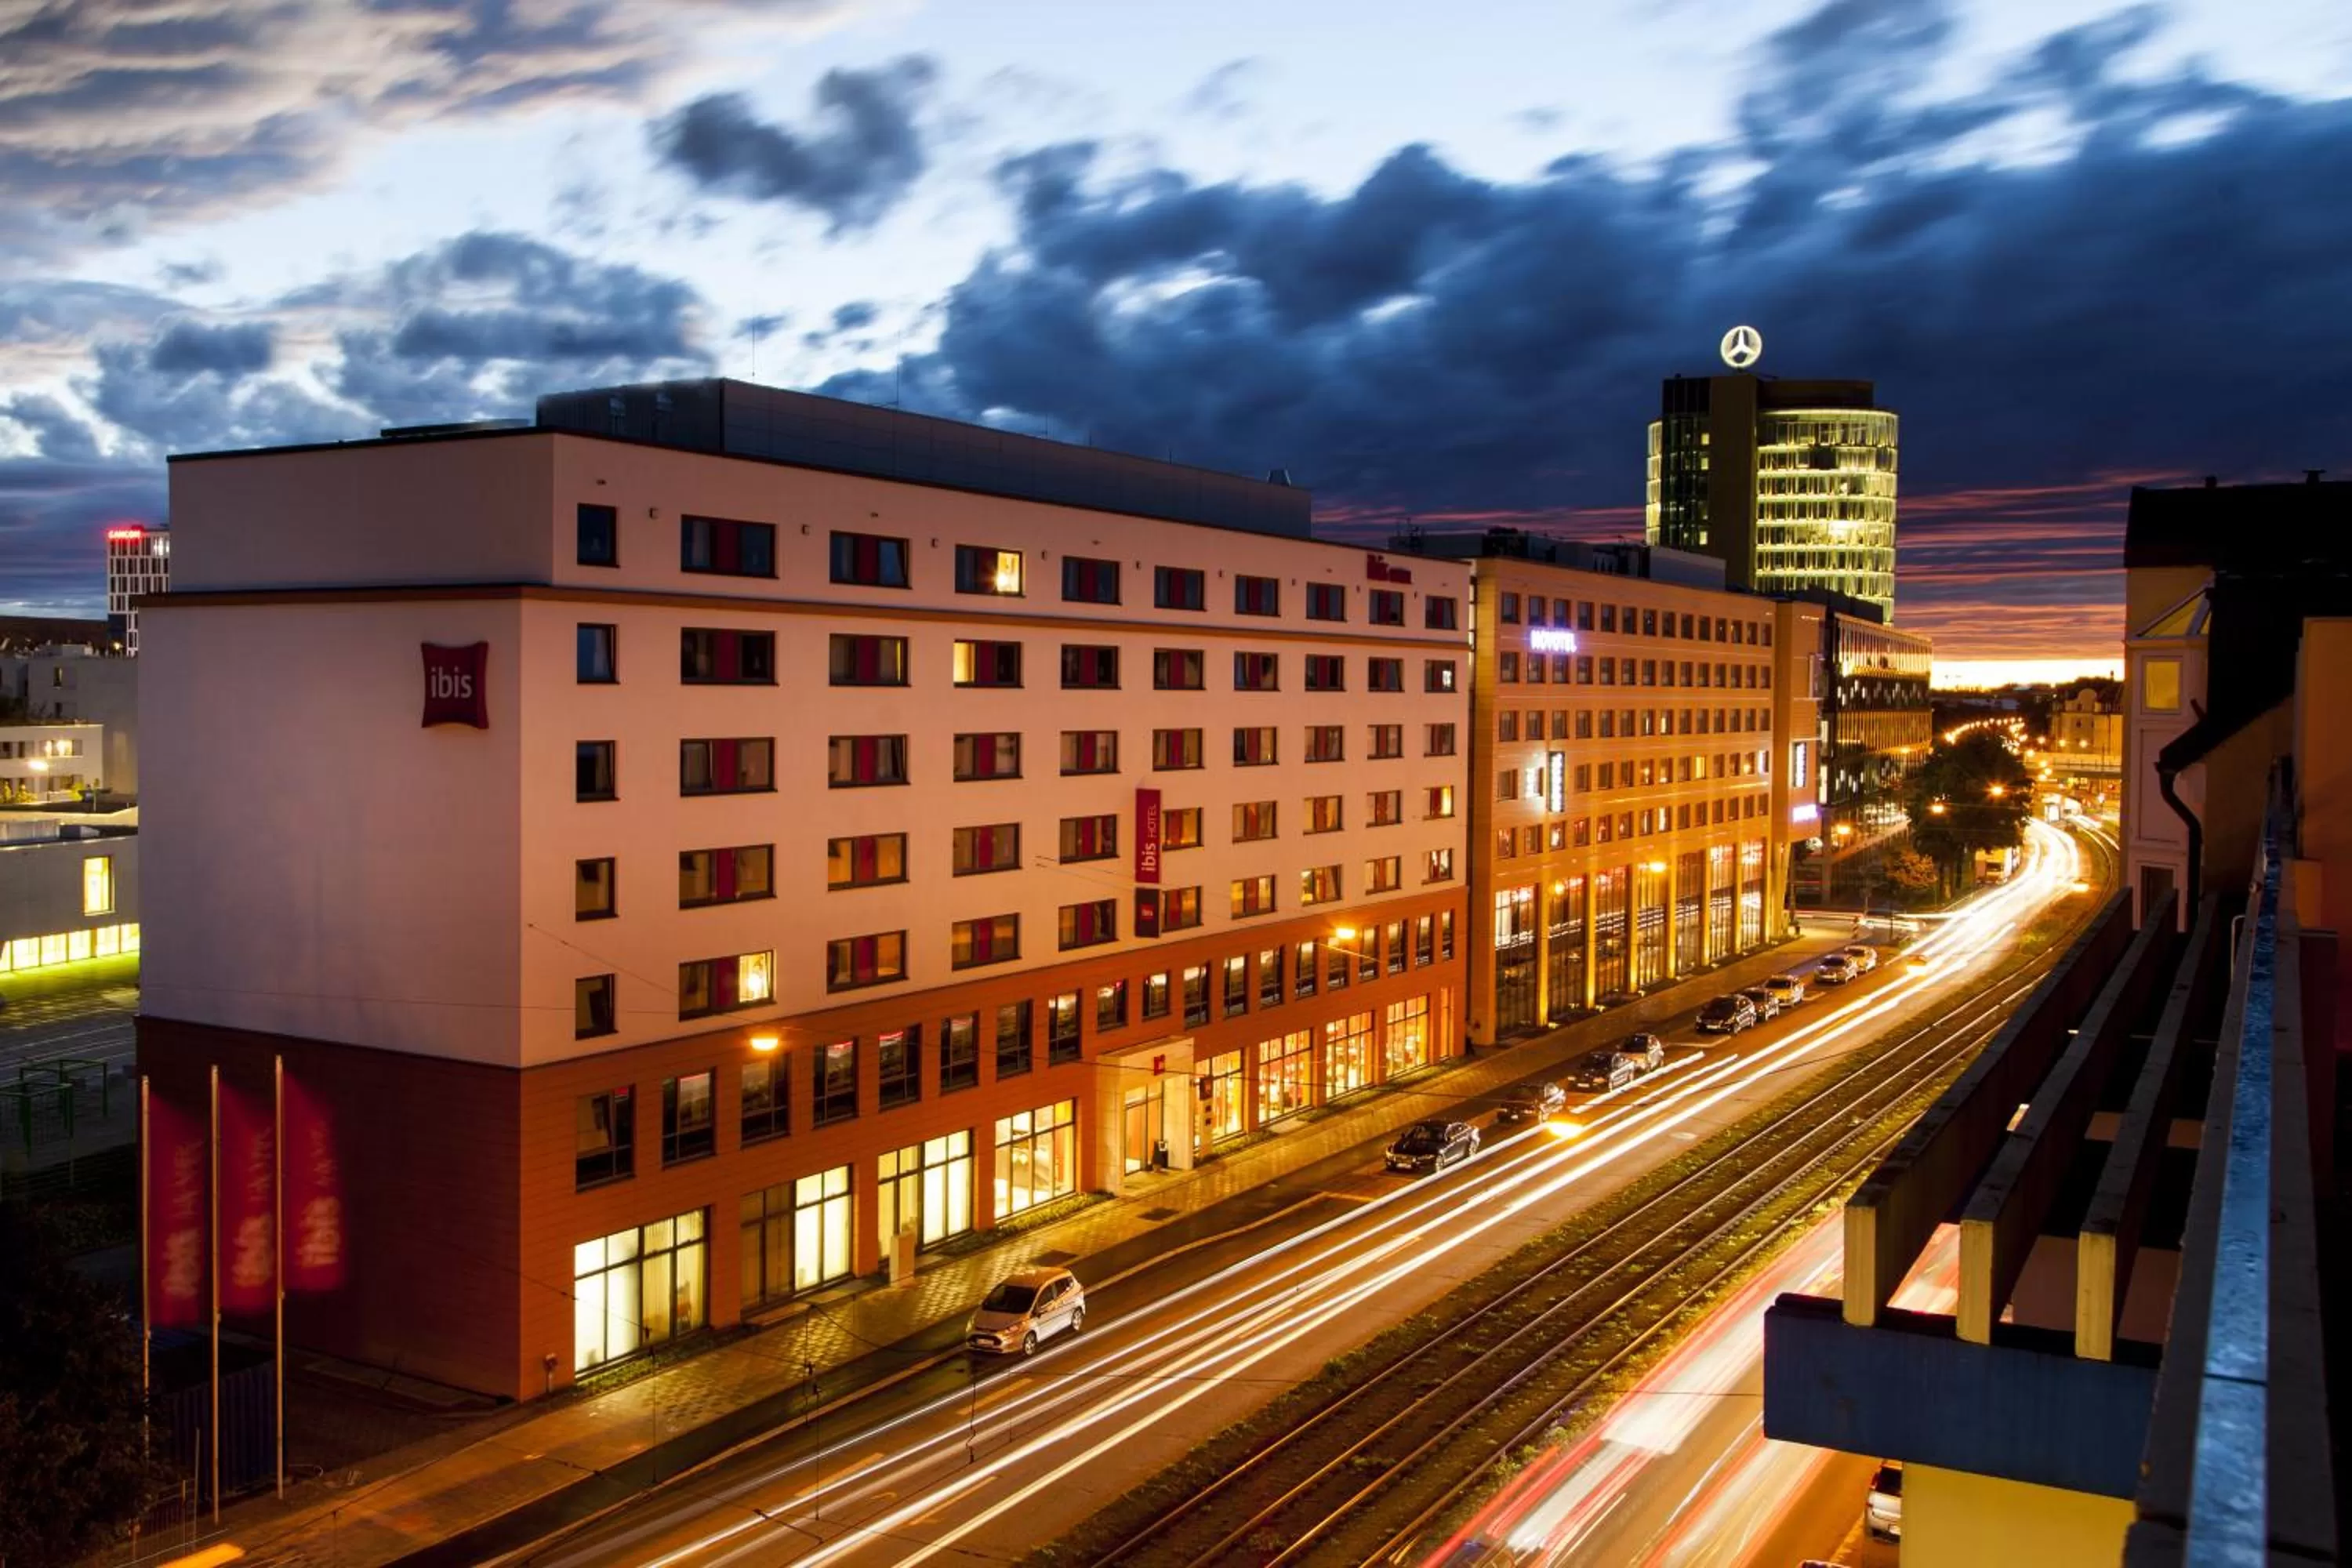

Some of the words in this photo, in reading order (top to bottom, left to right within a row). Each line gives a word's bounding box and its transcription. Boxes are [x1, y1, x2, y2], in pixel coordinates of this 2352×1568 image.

[431, 666, 472, 699] ibis
[1147, 804, 1157, 839] HOTEL
[1142, 843, 1156, 872] ibis
